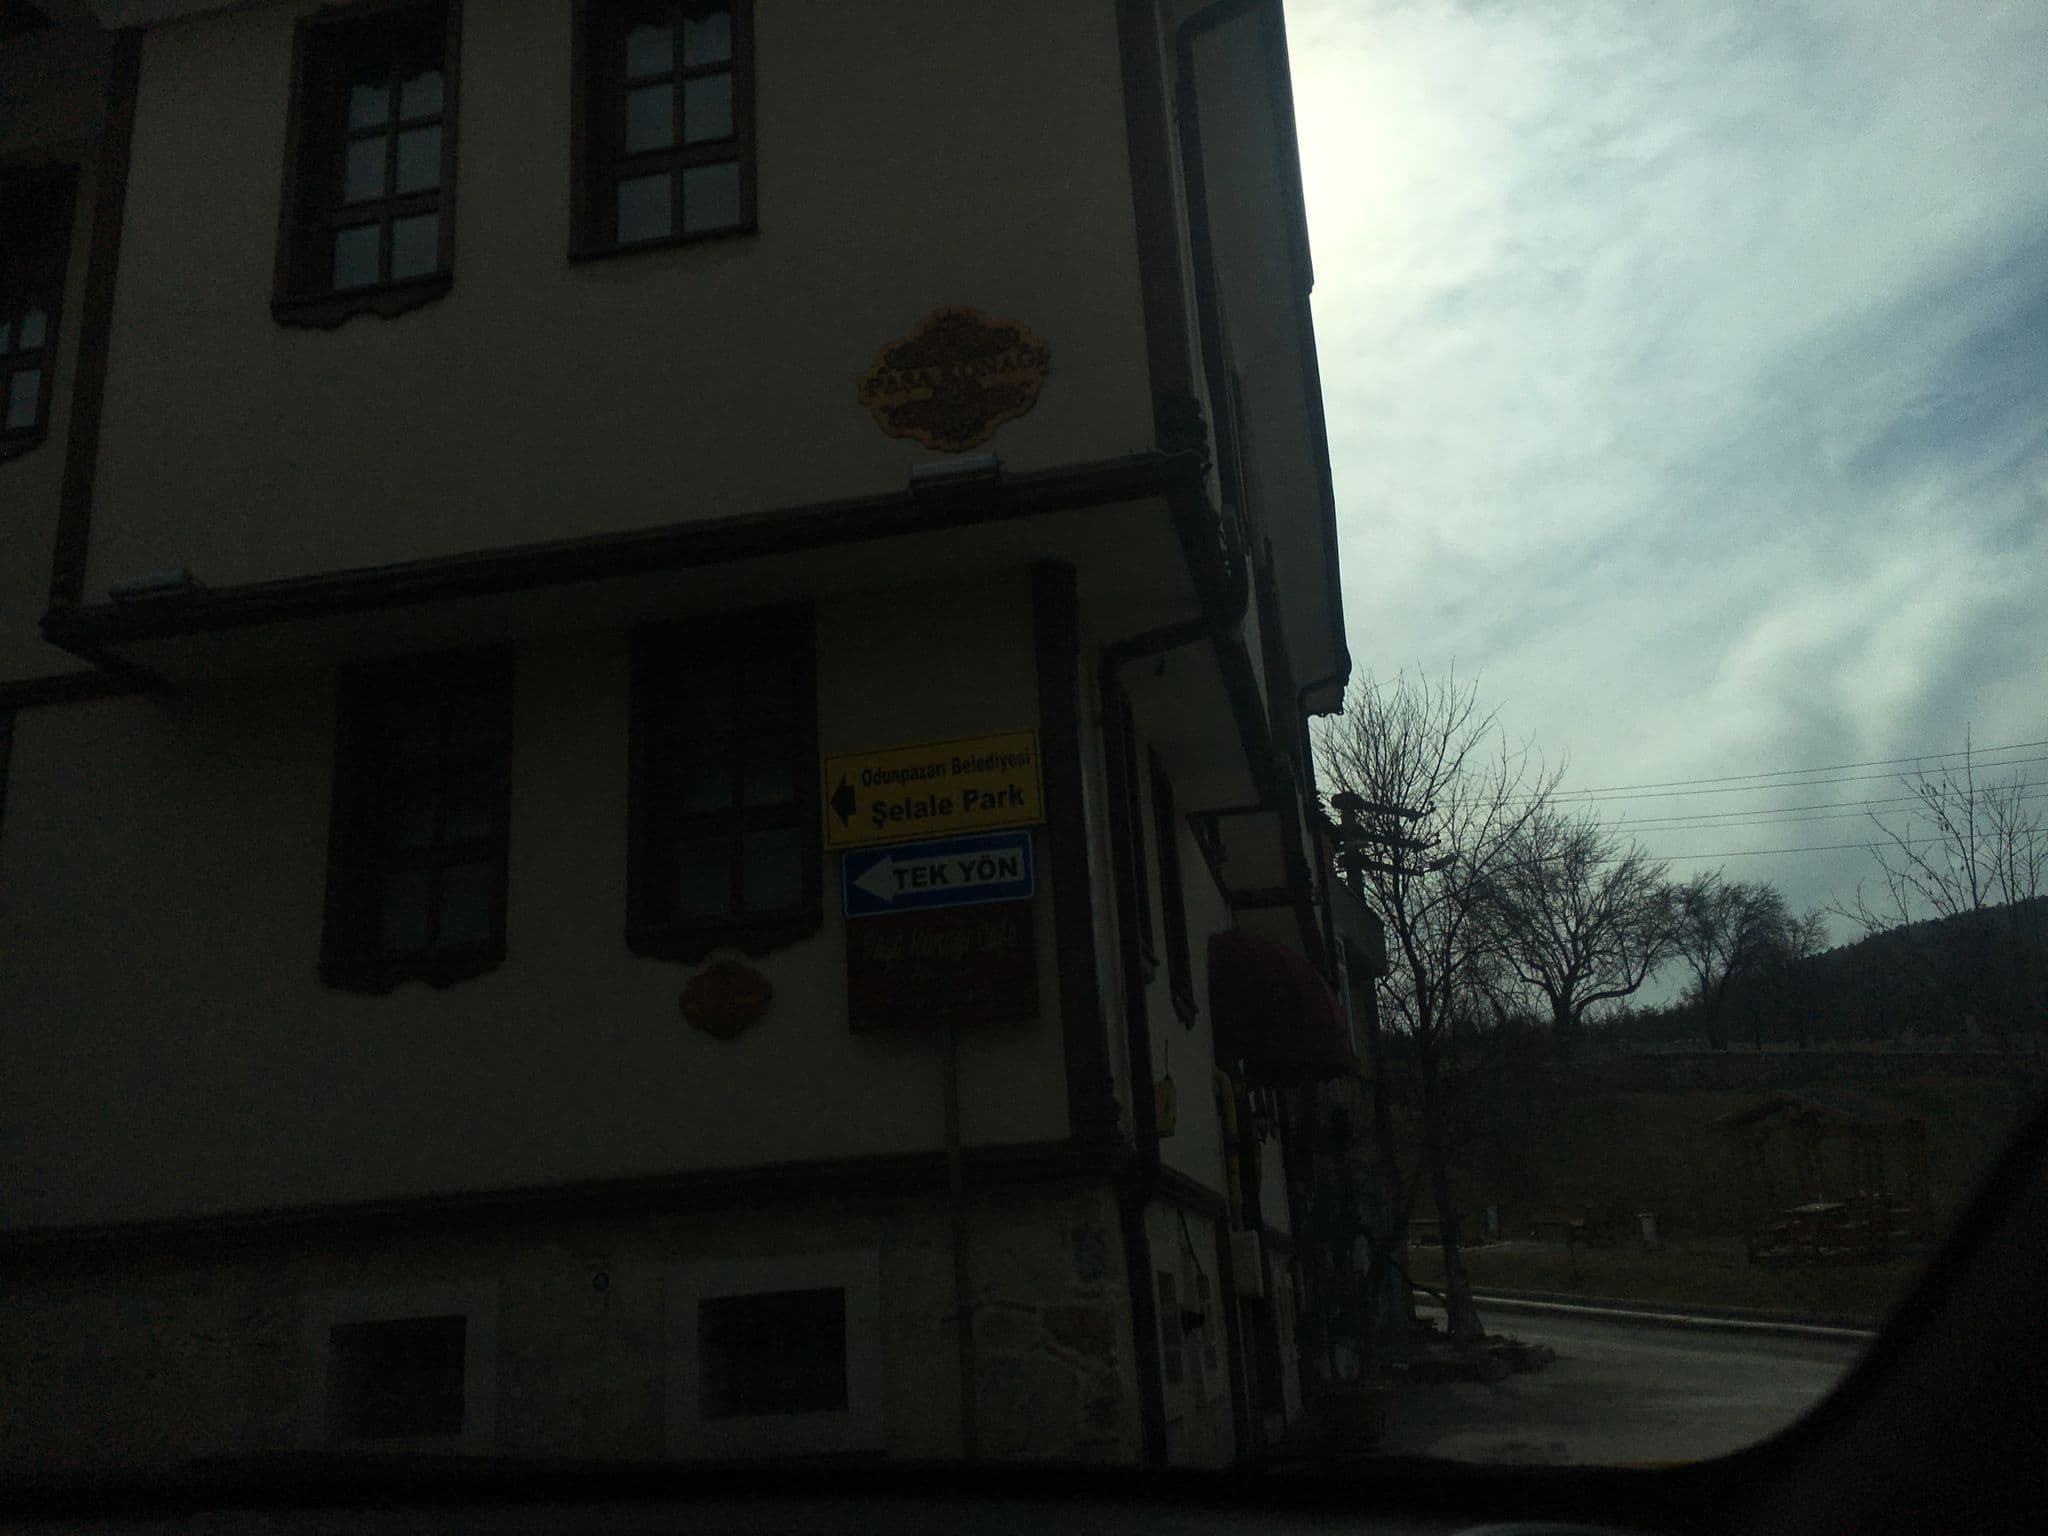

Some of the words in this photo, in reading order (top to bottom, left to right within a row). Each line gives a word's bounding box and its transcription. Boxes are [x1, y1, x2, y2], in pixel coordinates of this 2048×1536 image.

[951, 749, 1030, 775] Belediyesi
[871, 795, 953, 830] Şelale
[962, 784, 1025, 812] Park
[892, 864, 949, 890] TEK
[958, 853, 1018, 879] YÖN
